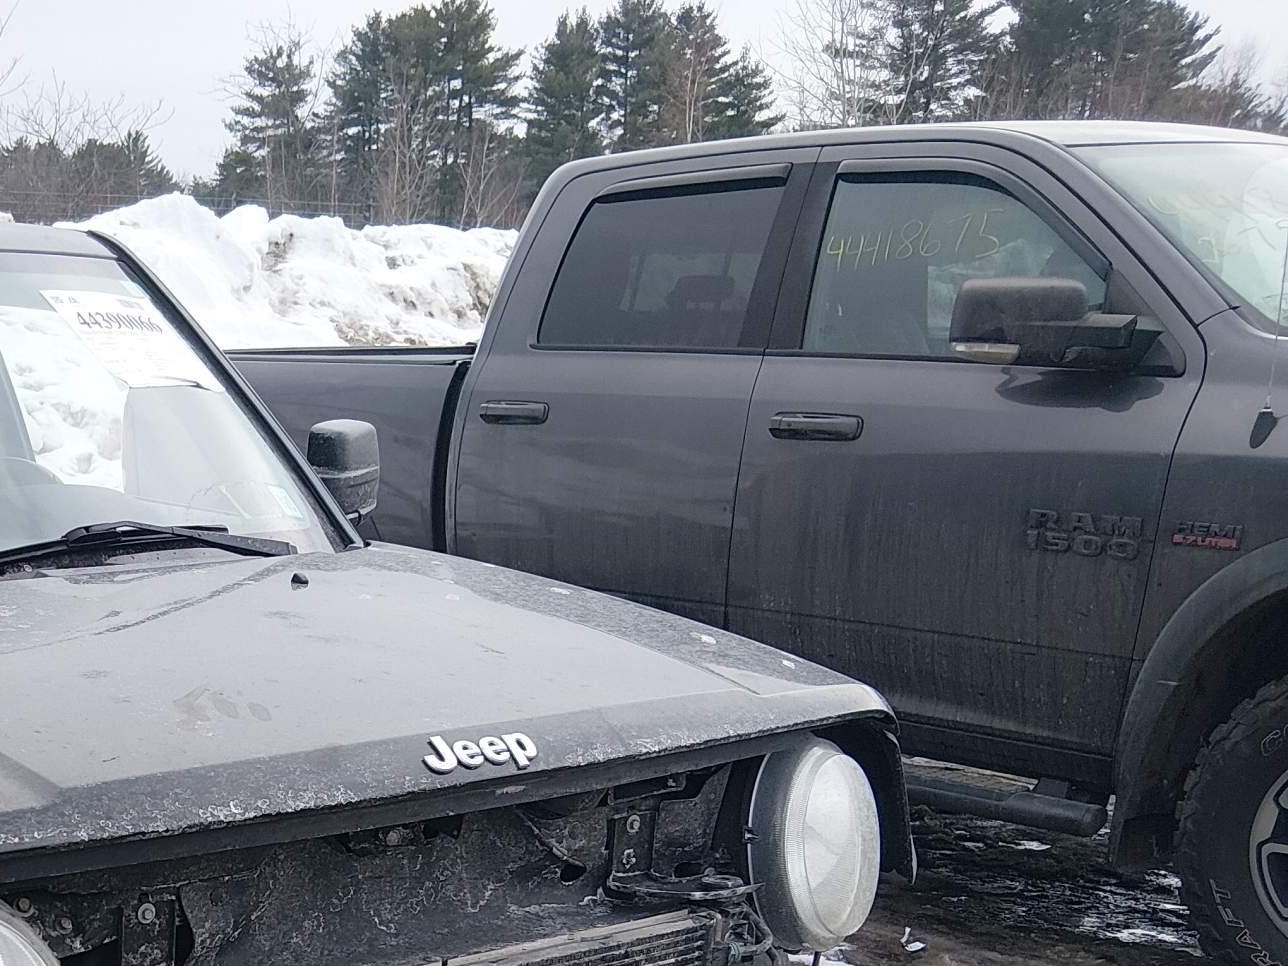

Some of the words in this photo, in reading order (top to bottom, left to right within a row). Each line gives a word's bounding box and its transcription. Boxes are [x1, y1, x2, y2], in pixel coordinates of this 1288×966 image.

[76, 311, 163, 334] 44390066
[1027, 508, 1143, 537] RAM
[1026, 528, 1139, 560] 1500
[422, 732, 539, 775] Jeep
